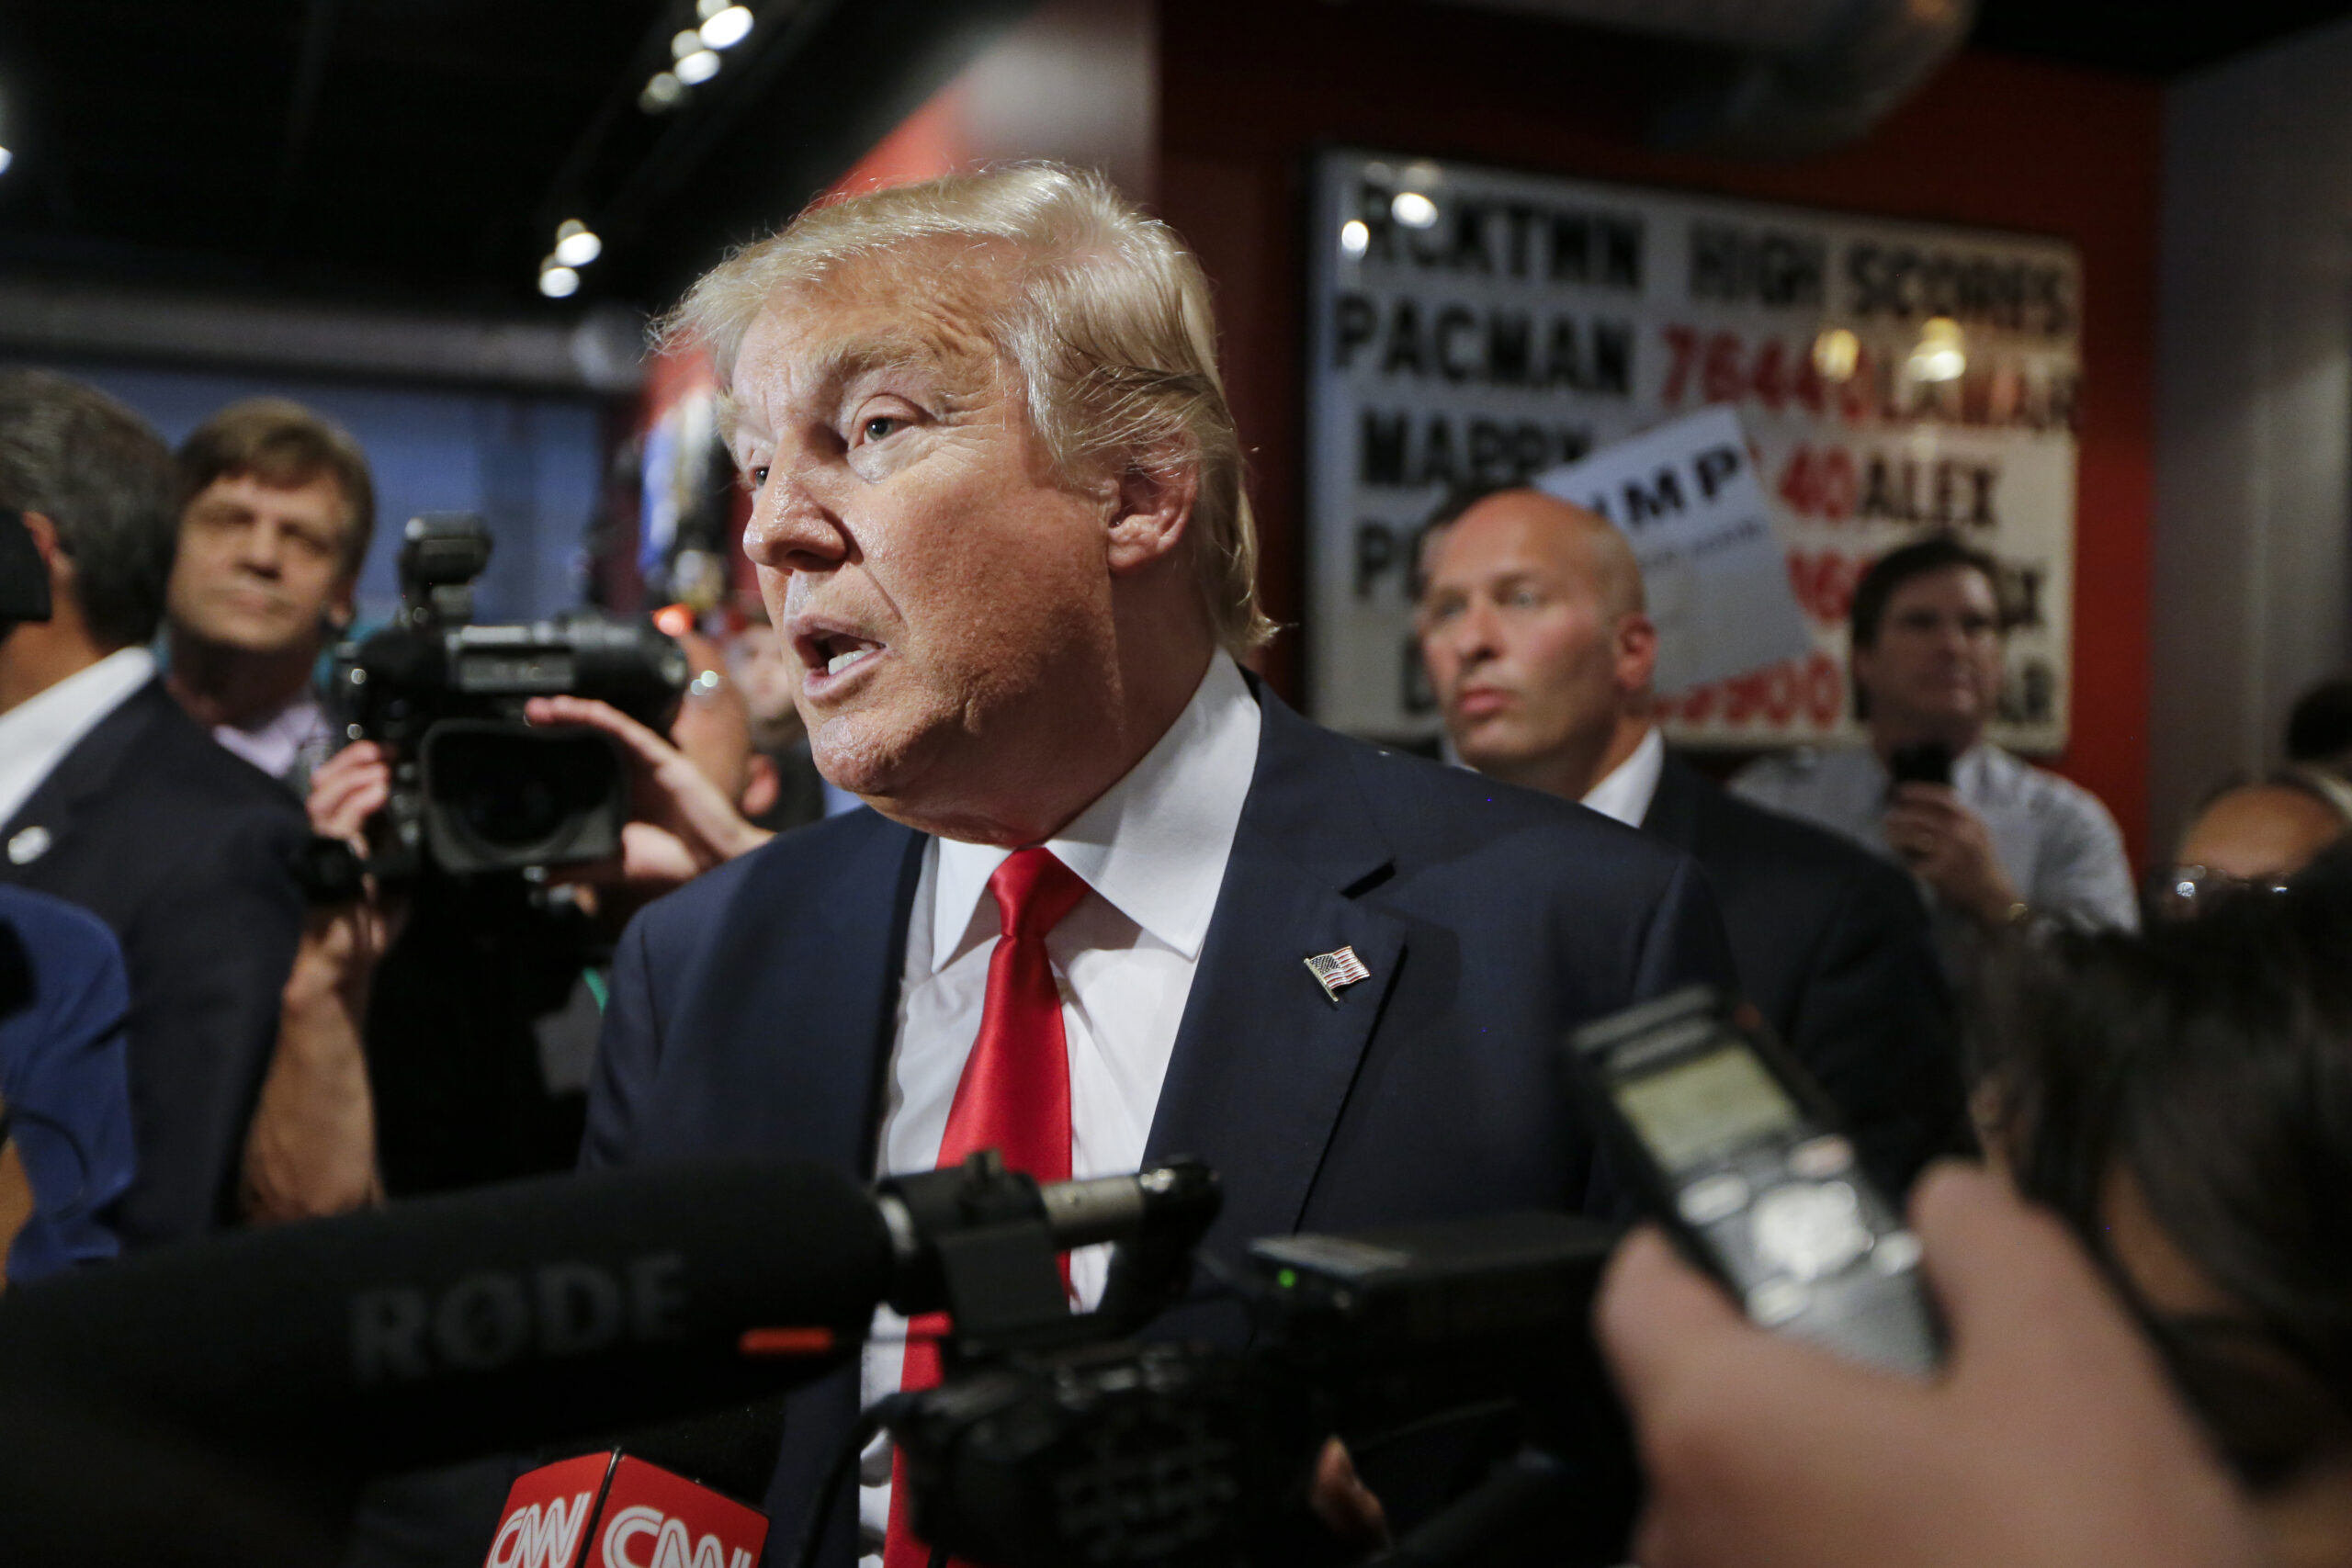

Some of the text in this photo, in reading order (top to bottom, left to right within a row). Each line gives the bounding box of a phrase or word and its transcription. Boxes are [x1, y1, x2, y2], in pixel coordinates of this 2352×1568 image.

[1688, 219, 1829, 310] HIGH
[1847, 240, 2071, 337] SCORES
[1334, 293, 1633, 395] PACMAN
[1591, 446, 1739, 529] MP
[1858, 445, 1999, 526] ALEX
[483, 1490, 593, 1568] CNN
